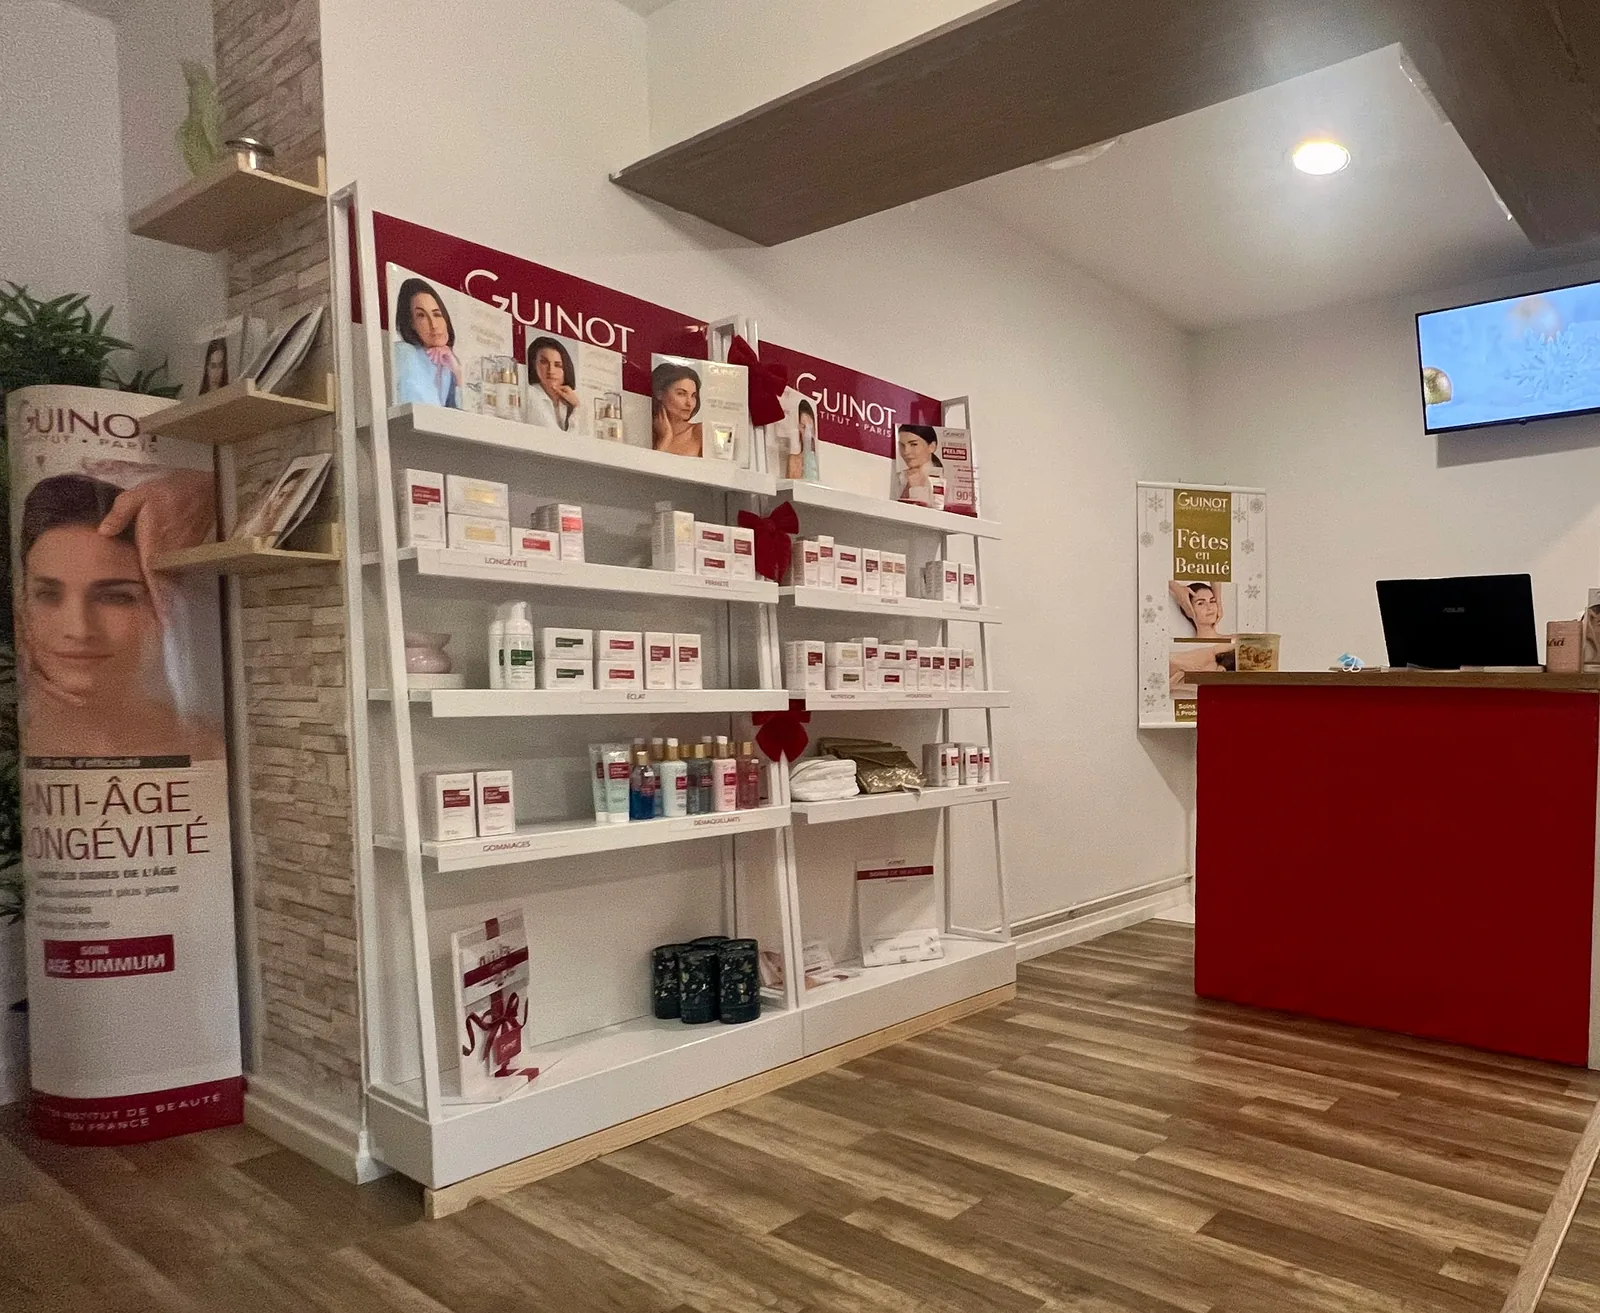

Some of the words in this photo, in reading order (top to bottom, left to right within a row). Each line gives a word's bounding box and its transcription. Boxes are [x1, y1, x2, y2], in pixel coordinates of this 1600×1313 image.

[464, 269, 635, 353] GUINOT
[796, 372, 897, 429] GUINOT
[21, 400, 157, 443] GUINO
[818, 410, 851, 427] TITUT
[863, 423, 892, 438] PARIS
[1177, 491, 1229, 509] GUINOT
[1176, 528, 1230, 551] Fêtes
[1175, 557, 1231, 576] Beauté
[1195, 551, 1210, 560] en
[626, 691, 647, 701] ÉCLAT
[27, 815, 211, 861] ONGÉVITÉ
[74, 953, 166, 974] SUMMUM
[126, 1107, 148, 1118] DE
[155, 1092, 223, 1115] BEAUTÉ
[86, 1117, 151, 1133] FRANCE
